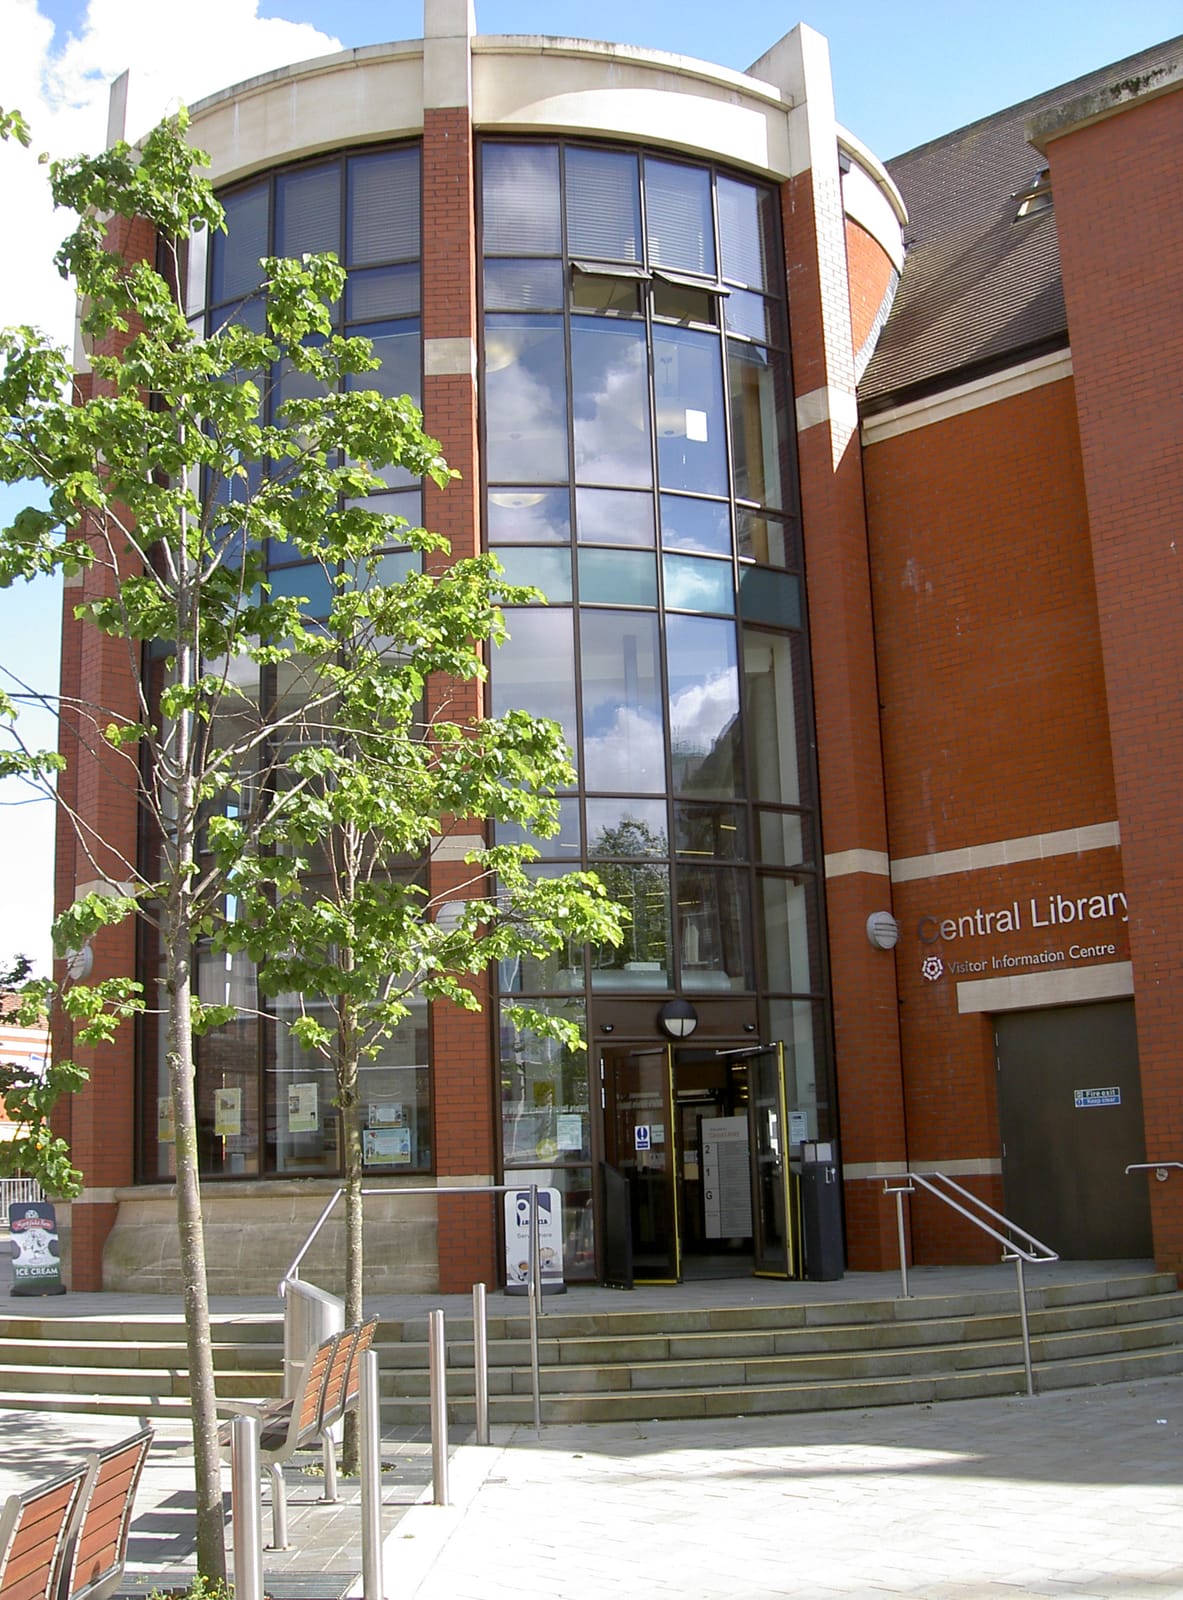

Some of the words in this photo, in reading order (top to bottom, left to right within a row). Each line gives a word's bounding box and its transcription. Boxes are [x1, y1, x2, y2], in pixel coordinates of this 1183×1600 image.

[918, 902, 1020, 944] Central
[1030, 891, 1129, 928] Library
[948, 959, 988, 975] Visitor
[992, 950, 1065, 969] Information
[1069, 944, 1116, 960] Centre
[705, 1145, 711, 1154] 2
[706, 1168, 711, 1177] 1
[705, 1190, 713, 1200] G
[16, 1268, 29, 1276] ICE
[30, 1267, 58, 1275] CREAM
